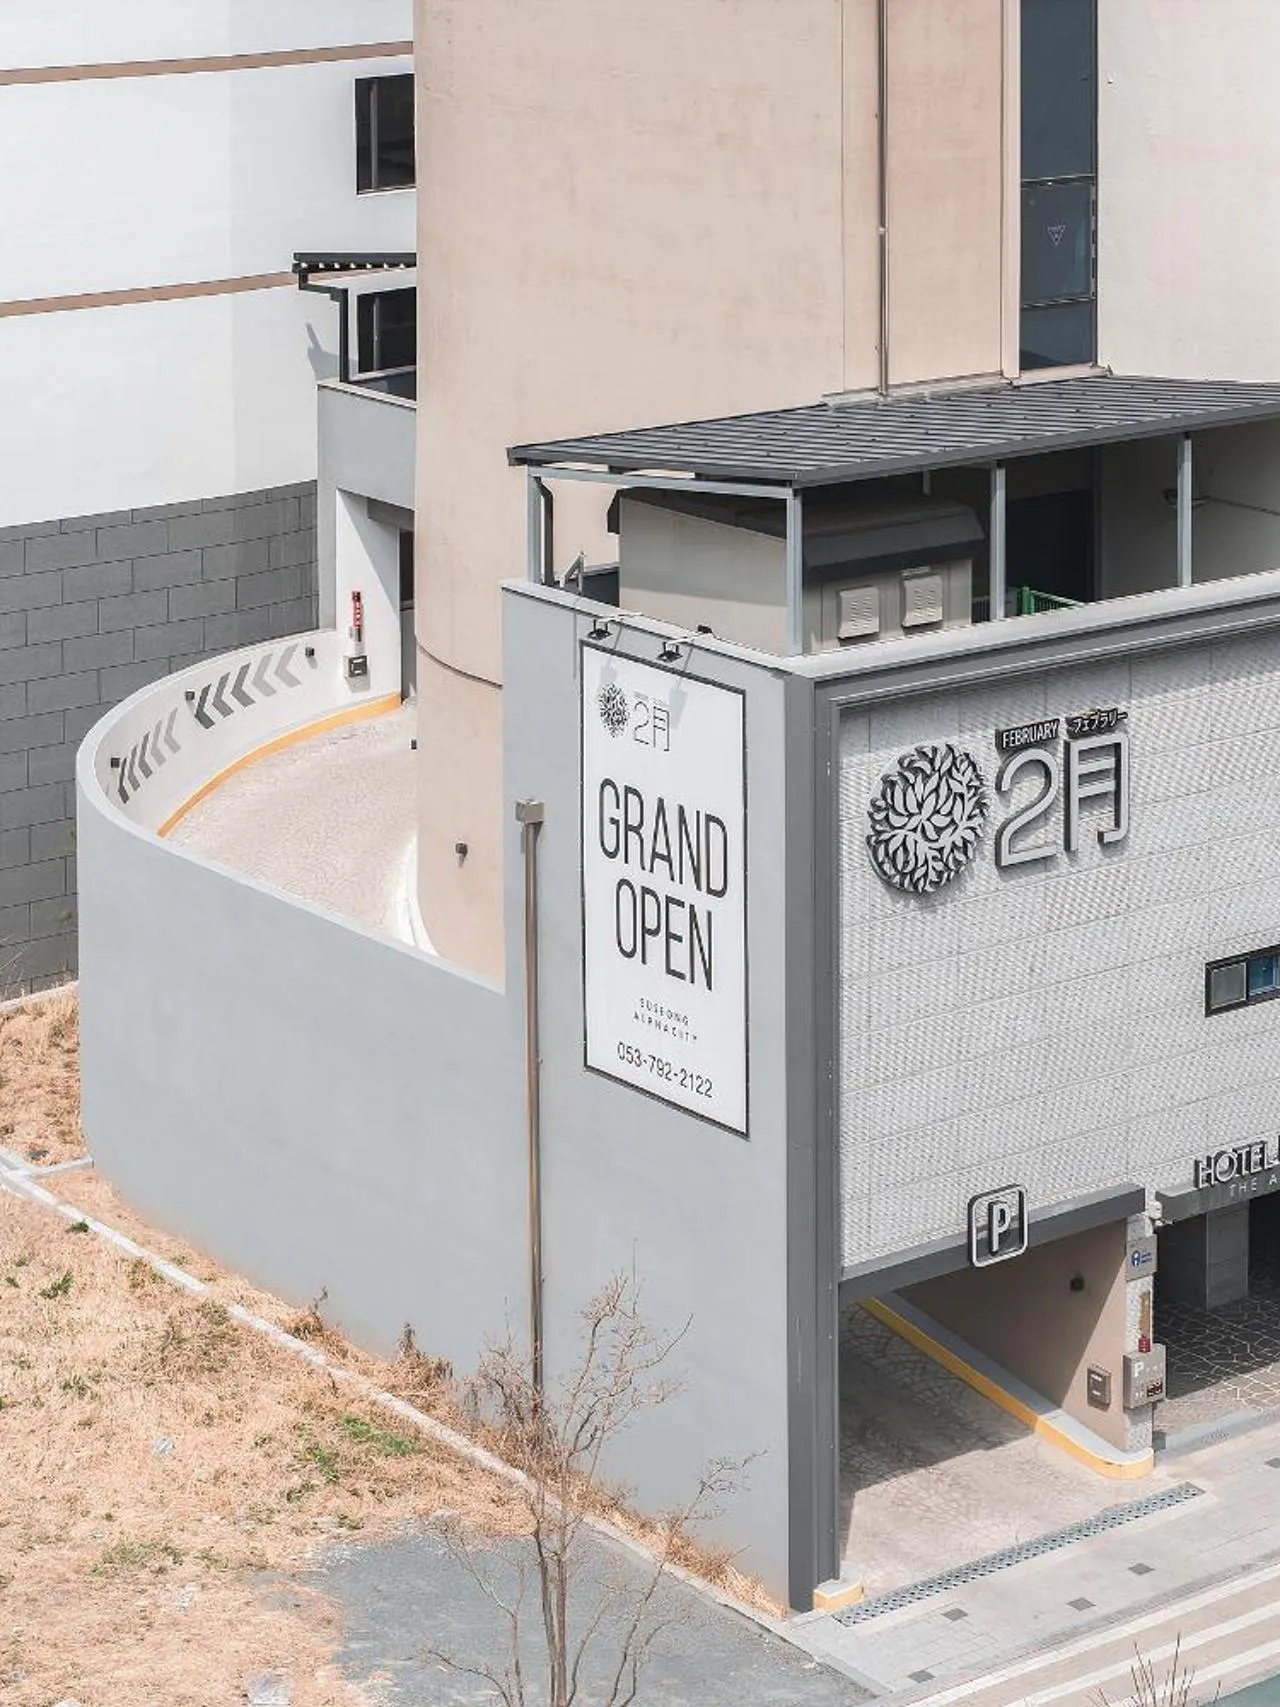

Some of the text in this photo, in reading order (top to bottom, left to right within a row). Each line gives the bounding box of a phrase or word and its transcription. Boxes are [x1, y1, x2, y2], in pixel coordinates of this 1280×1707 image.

[1001, 719, 1059, 749] FEBRUARY
[599, 777, 728, 898] GRAND
[615, 878, 713, 991] OPEN
[617, 1041, 713, 1099] 053-792-2122
[1196, 1140, 1280, 1189] HOTEL
[1228, 1176, 1258, 1198] THE
[990, 1201, 1012, 1256] P
